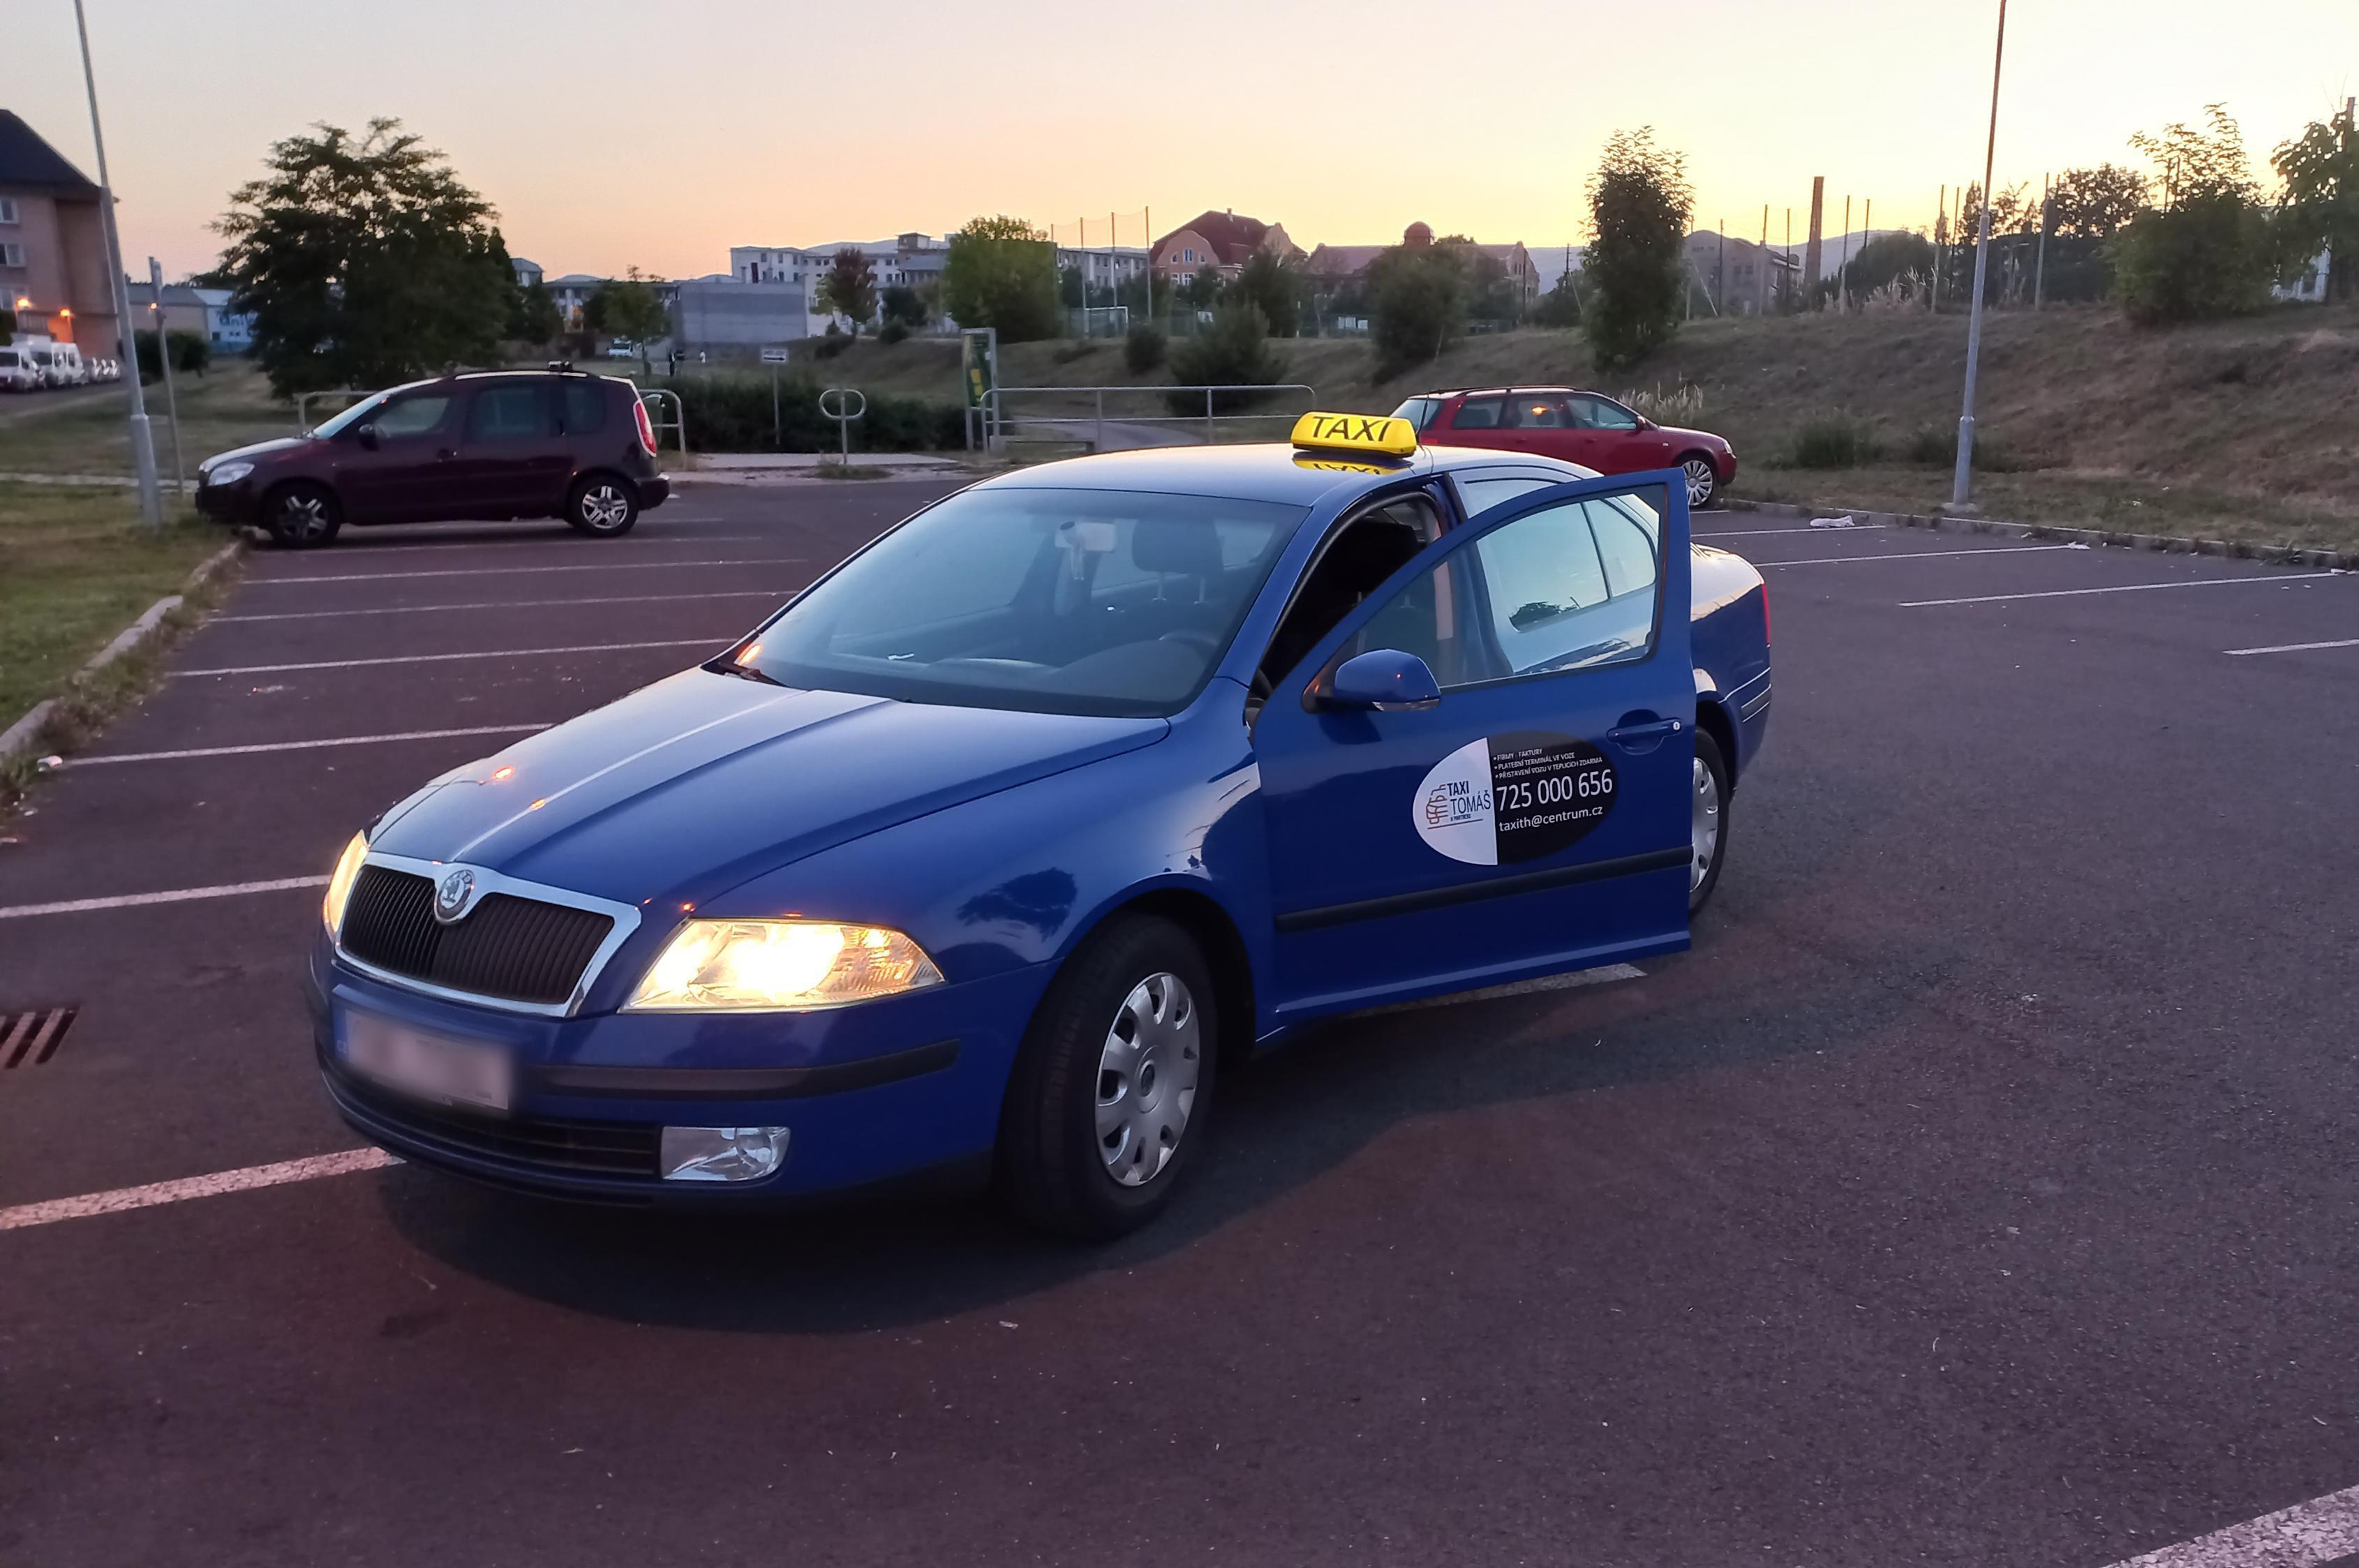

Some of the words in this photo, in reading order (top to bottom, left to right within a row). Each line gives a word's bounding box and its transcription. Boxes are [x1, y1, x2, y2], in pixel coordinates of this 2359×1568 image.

[1312, 416, 1392, 442] TAXI
[1518, 749, 1542, 757] FAKTURY
[1524, 754, 1552, 766] TERMINÁL
[1498, 767, 1531, 779] PŘISTAVENÍ
[1579, 756, 1602, 767] ZDARMA
[1447, 780, 1469, 796] TAXI
[1496, 782, 1532, 811] 725
[1538, 775, 1572, 804] 000
[1578, 769, 1612, 797] 656
[1450, 789, 1491, 815] TOMÁŠ
[1499, 806, 1603, 832] taxith@centrum.cz
